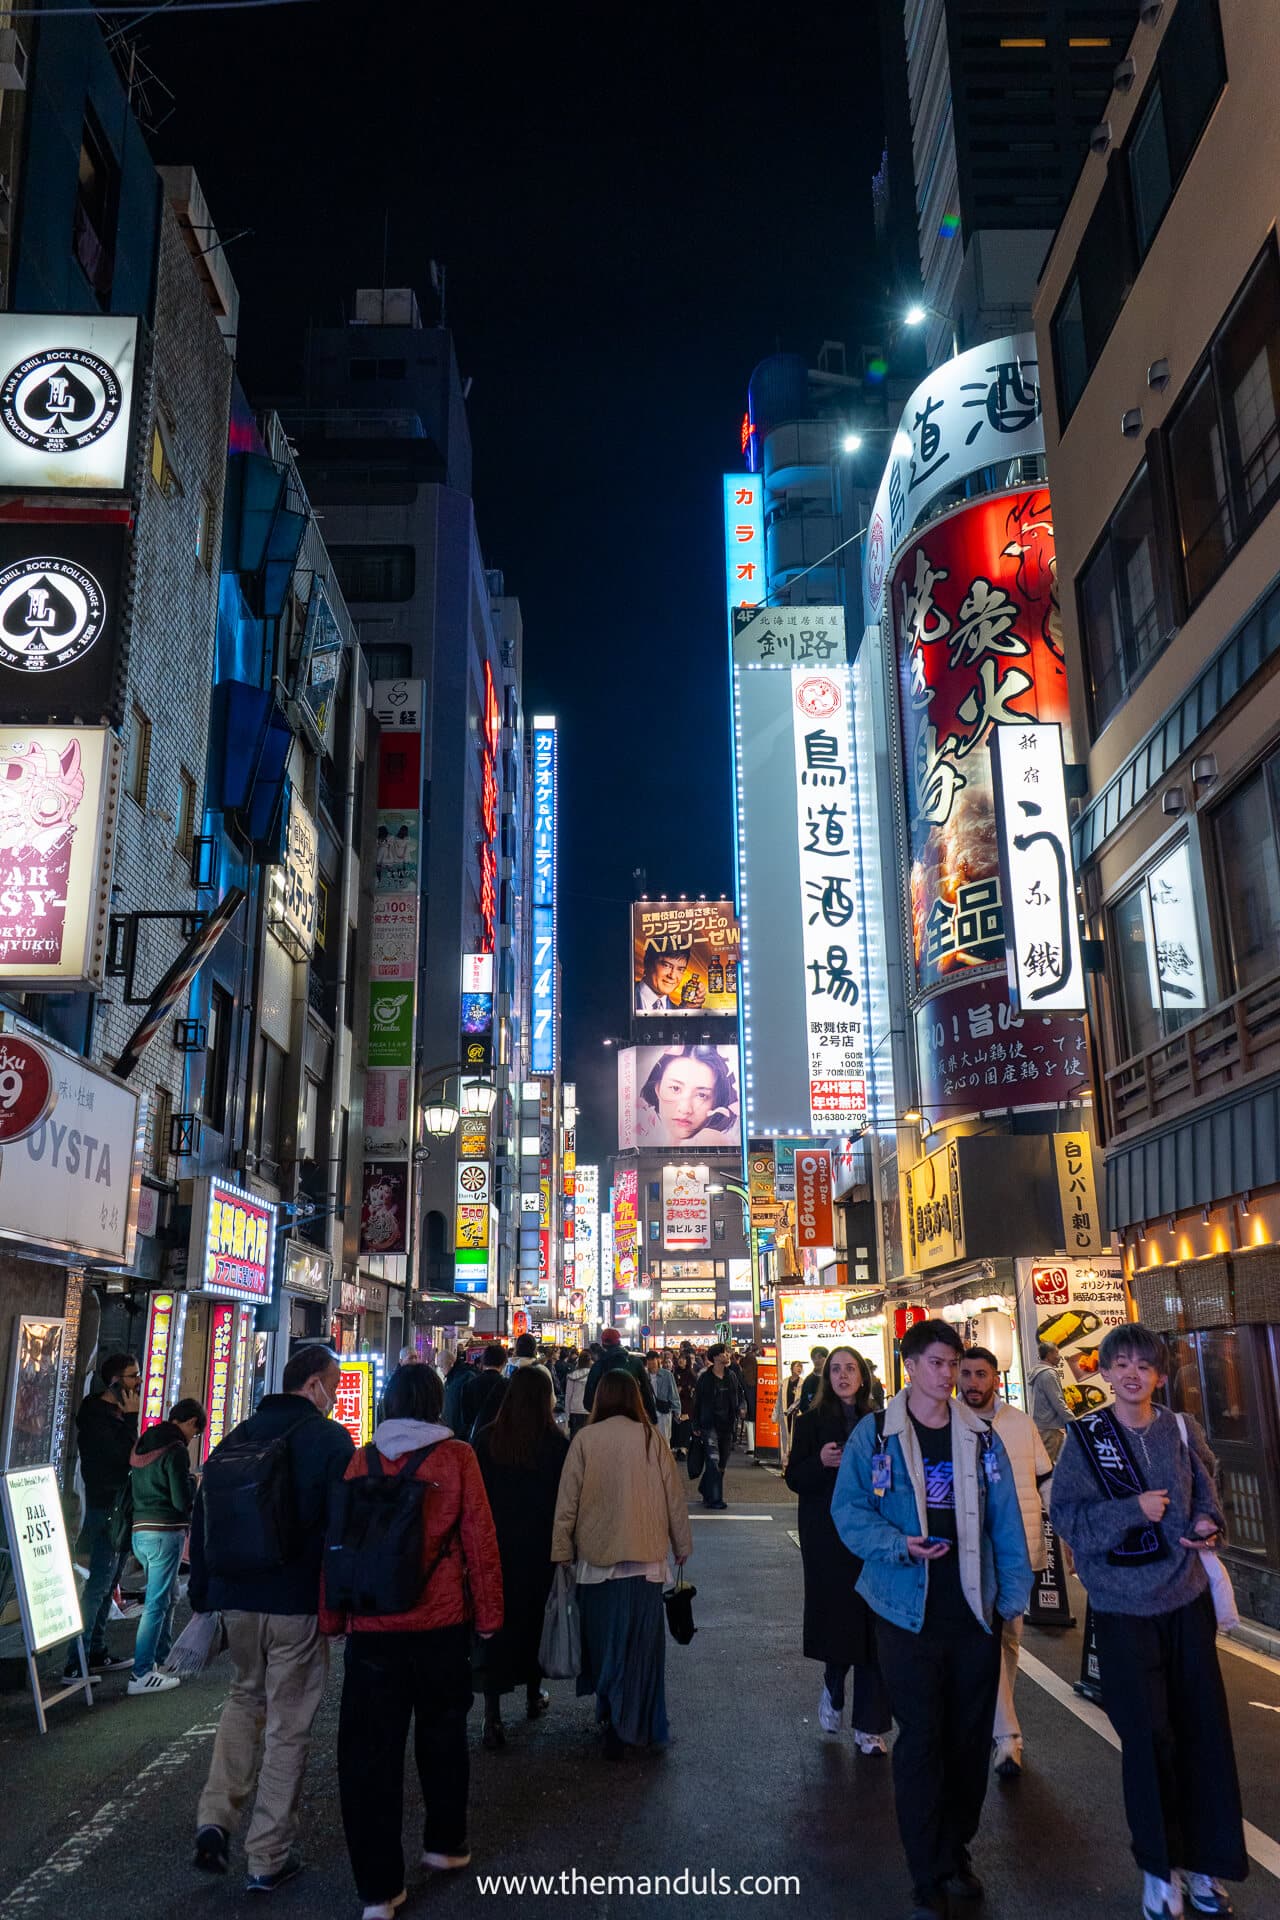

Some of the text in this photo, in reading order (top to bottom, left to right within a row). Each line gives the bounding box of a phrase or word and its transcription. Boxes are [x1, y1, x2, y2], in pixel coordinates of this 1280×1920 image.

[6, 378, 17, 393] BAR
[47, 352, 71, 361] ROCK
[72, 352, 79, 360] &
[80, 355, 98, 369] ROLL
[96, 366, 117, 396] LOUNGE
[4, 408, 39, 445] PRODUCED BY
[26, 561, 52, 571] ROCK
[52, 562, 60, 571] &
[60, 564, 81, 580] ROLL
[78, 575, 99, 607] LOUNGE
[736, 609, 755, 622] 4F
[760, 615, 839, 626] 北海道居酒屋
[6, 652, 18, 662] BY
[1018, 732, 1041, 784] 新宿
[801, 728, 859, 1006] 鳥道酒場
[642, 916, 729, 936] ワンランク上の
[644, 927, 741, 952] ヘパリーゼW
[810, 1021, 862, 1034] 歌舞伎町
[819, 1035, 854, 1047] 2号店
[811, 1052, 864, 1060] 1F 60席
[840, 1060, 864, 1068] 100席
[812, 1069, 822, 1077] 3F
[812, 1081, 864, 1094] 24H営業
[812, 1095, 865, 1109] 年中無休
[812, 1113, 867, 1121] 03-6380-2709
[26, 1119, 112, 1188] OYSTA
[817, 1156, 828, 1205] Girls Bar
[474, 1191, 487, 1200] UP
[800, 1156, 817, 1240] Orange
[1064, 1141, 1092, 1248] 白レバー刺し
[671, 1198, 701, 1206] カラオケ
[666, 1209, 708, 1221] まねきねこ
[695, 1225, 708, 1233] 3F
[25, 1503, 48, 1520] BAR
[32, 1543, 53, 1558] TOKYO
